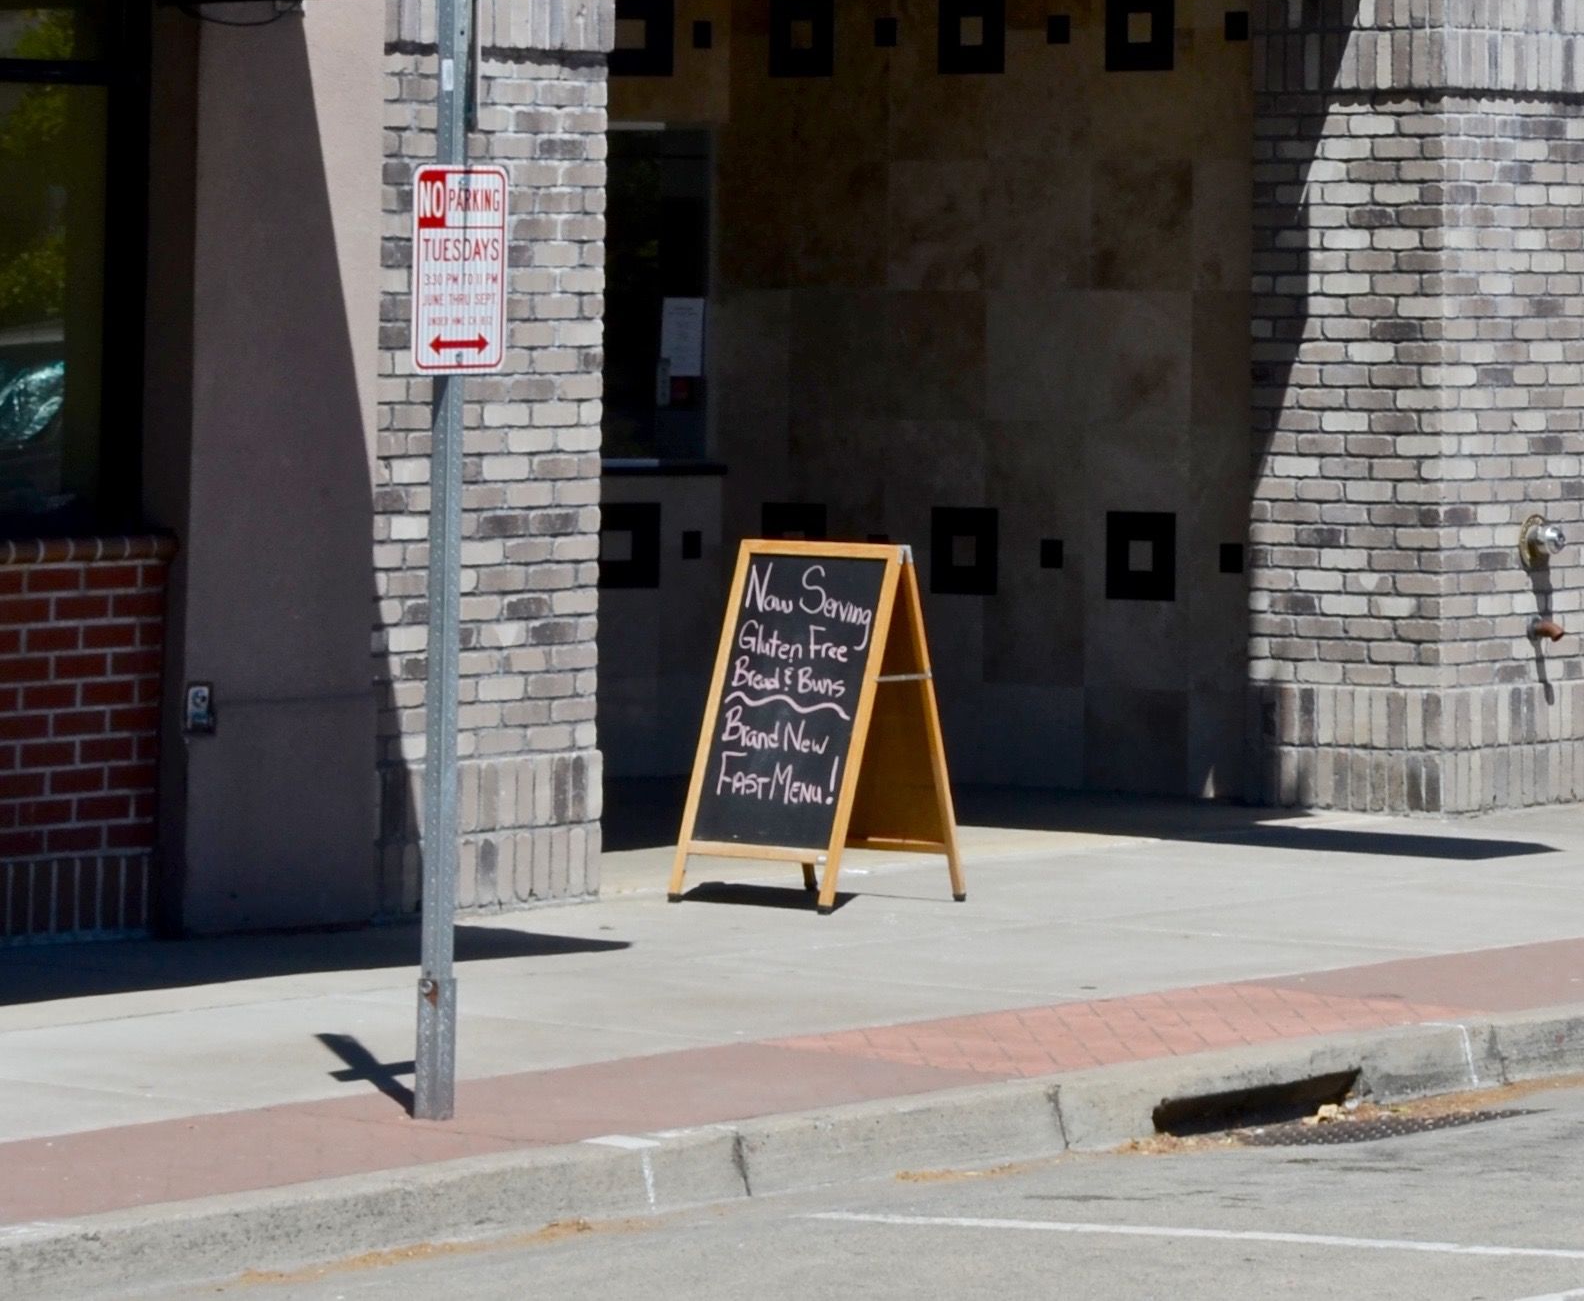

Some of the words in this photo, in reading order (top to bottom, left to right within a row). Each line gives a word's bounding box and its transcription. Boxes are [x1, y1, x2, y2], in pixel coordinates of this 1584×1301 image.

[419, 180, 444, 219] NO
[448, 188, 500, 213] PARKING
[423, 238, 500, 262] TUESDAYS
[446, 273, 458, 286] PM
[462, 273, 473, 286] TO
[485, 273, 498, 286] PM
[744, 562, 793, 614] Now
[799, 565, 872, 651] Serving
[738, 619, 803, 664] Gluten
[809, 624, 848, 663] Free
[731, 655, 781, 692] Bread
[797, 667, 846, 698] Buns
[721, 705, 779, 748] Brand
[784, 720, 830, 754] New
